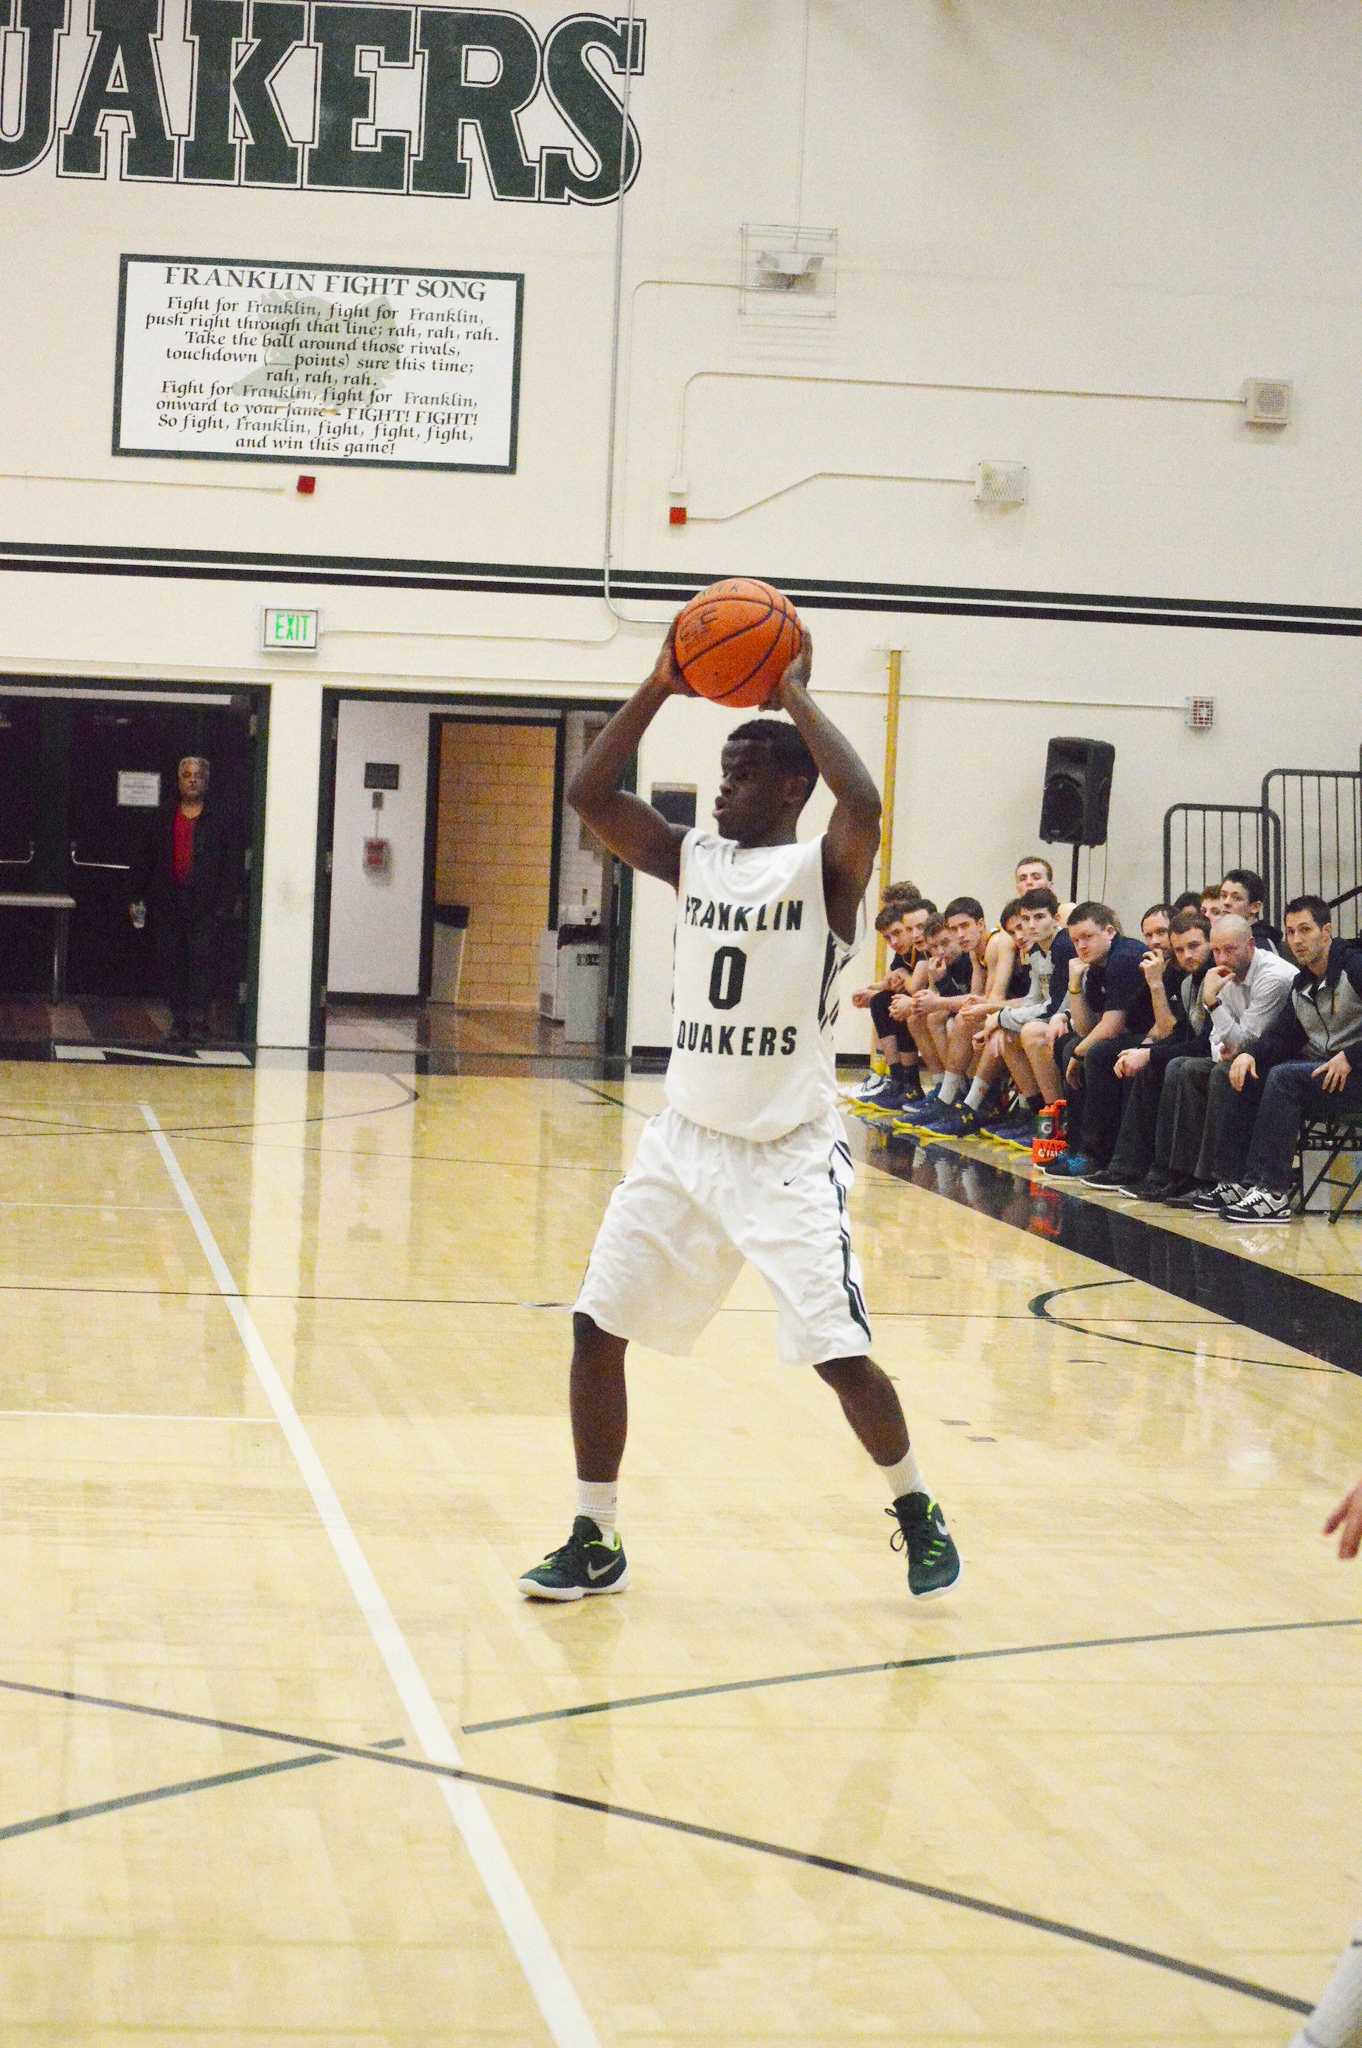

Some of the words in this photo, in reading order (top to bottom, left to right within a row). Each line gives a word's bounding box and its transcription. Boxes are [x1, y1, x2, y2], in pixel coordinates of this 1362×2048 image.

[164, 266, 316, 292] FRANKLIN
[324, 275, 410, 297] FIGHT
[416, 279, 487, 302] SONG
[167, 296, 210, 315] Fight
[212, 297, 239, 315] for
[247, 299, 321, 317] Franklin,
[328, 302, 371, 320] fight
[373, 304, 399, 323] for
[409, 307, 484, 326] Franklin,
[145, 312, 184, 330] push
[190, 313, 230, 333] right
[237, 315, 300, 335] through
[306, 319, 340, 333] that
[346, 320, 382, 336] line;
[388, 323, 422, 339] rah,
[427, 325, 460, 339] rah,
[466, 326, 499, 341] rah.
[185, 330, 226, 345] Take
[232, 331, 257, 346] the
[262, 333, 295, 349] ball
[299, 336, 357, 351] around
[362, 339, 404, 355] those
[410, 342, 461, 357] rivals,
[166, 347, 258, 363] touchdown
[294, 353, 349, 370] points)
[357, 358, 390, 370] sure
[395, 356, 426, 371] this
[432, 360, 474, 375] time;
[266, 368, 299, 383] rah,
[305, 370, 338, 385] rah,
[343, 372, 377, 386] rah.
[162, 380, 204, 398] Fight
[209, 381, 234, 398] for
[242, 384, 317, 402] Franklin,
[319, 386, 363, 405] fight
[367, 388, 392, 407] for
[404, 392, 478, 409] Franklin,
[156, 398, 217, 413] onward
[224, 402, 239, 413] to
[243, 404, 279, 419] your
[347, 407, 410, 423] FIGHT!
[415, 410, 478, 426] FIGHT!
[158, 414, 177, 427] So
[179, 415, 229, 433] fight,
[236, 417, 311, 435] Franklin,
[316, 420, 364, 439] fight,
[372, 423, 420, 442] fight,
[424, 425, 473, 444] fight,
[235, 435, 268, 449] and
[273, 439, 303, 450] win
[309, 436, 339, 451] this
[343, 442, 395, 457] game!
[275, 613, 310, 641] EXIT
[684, 895, 803, 931] FRANKLIN
[708, 945, 747, 1010] 0
[677, 1020, 797, 1056] QUAKERS
